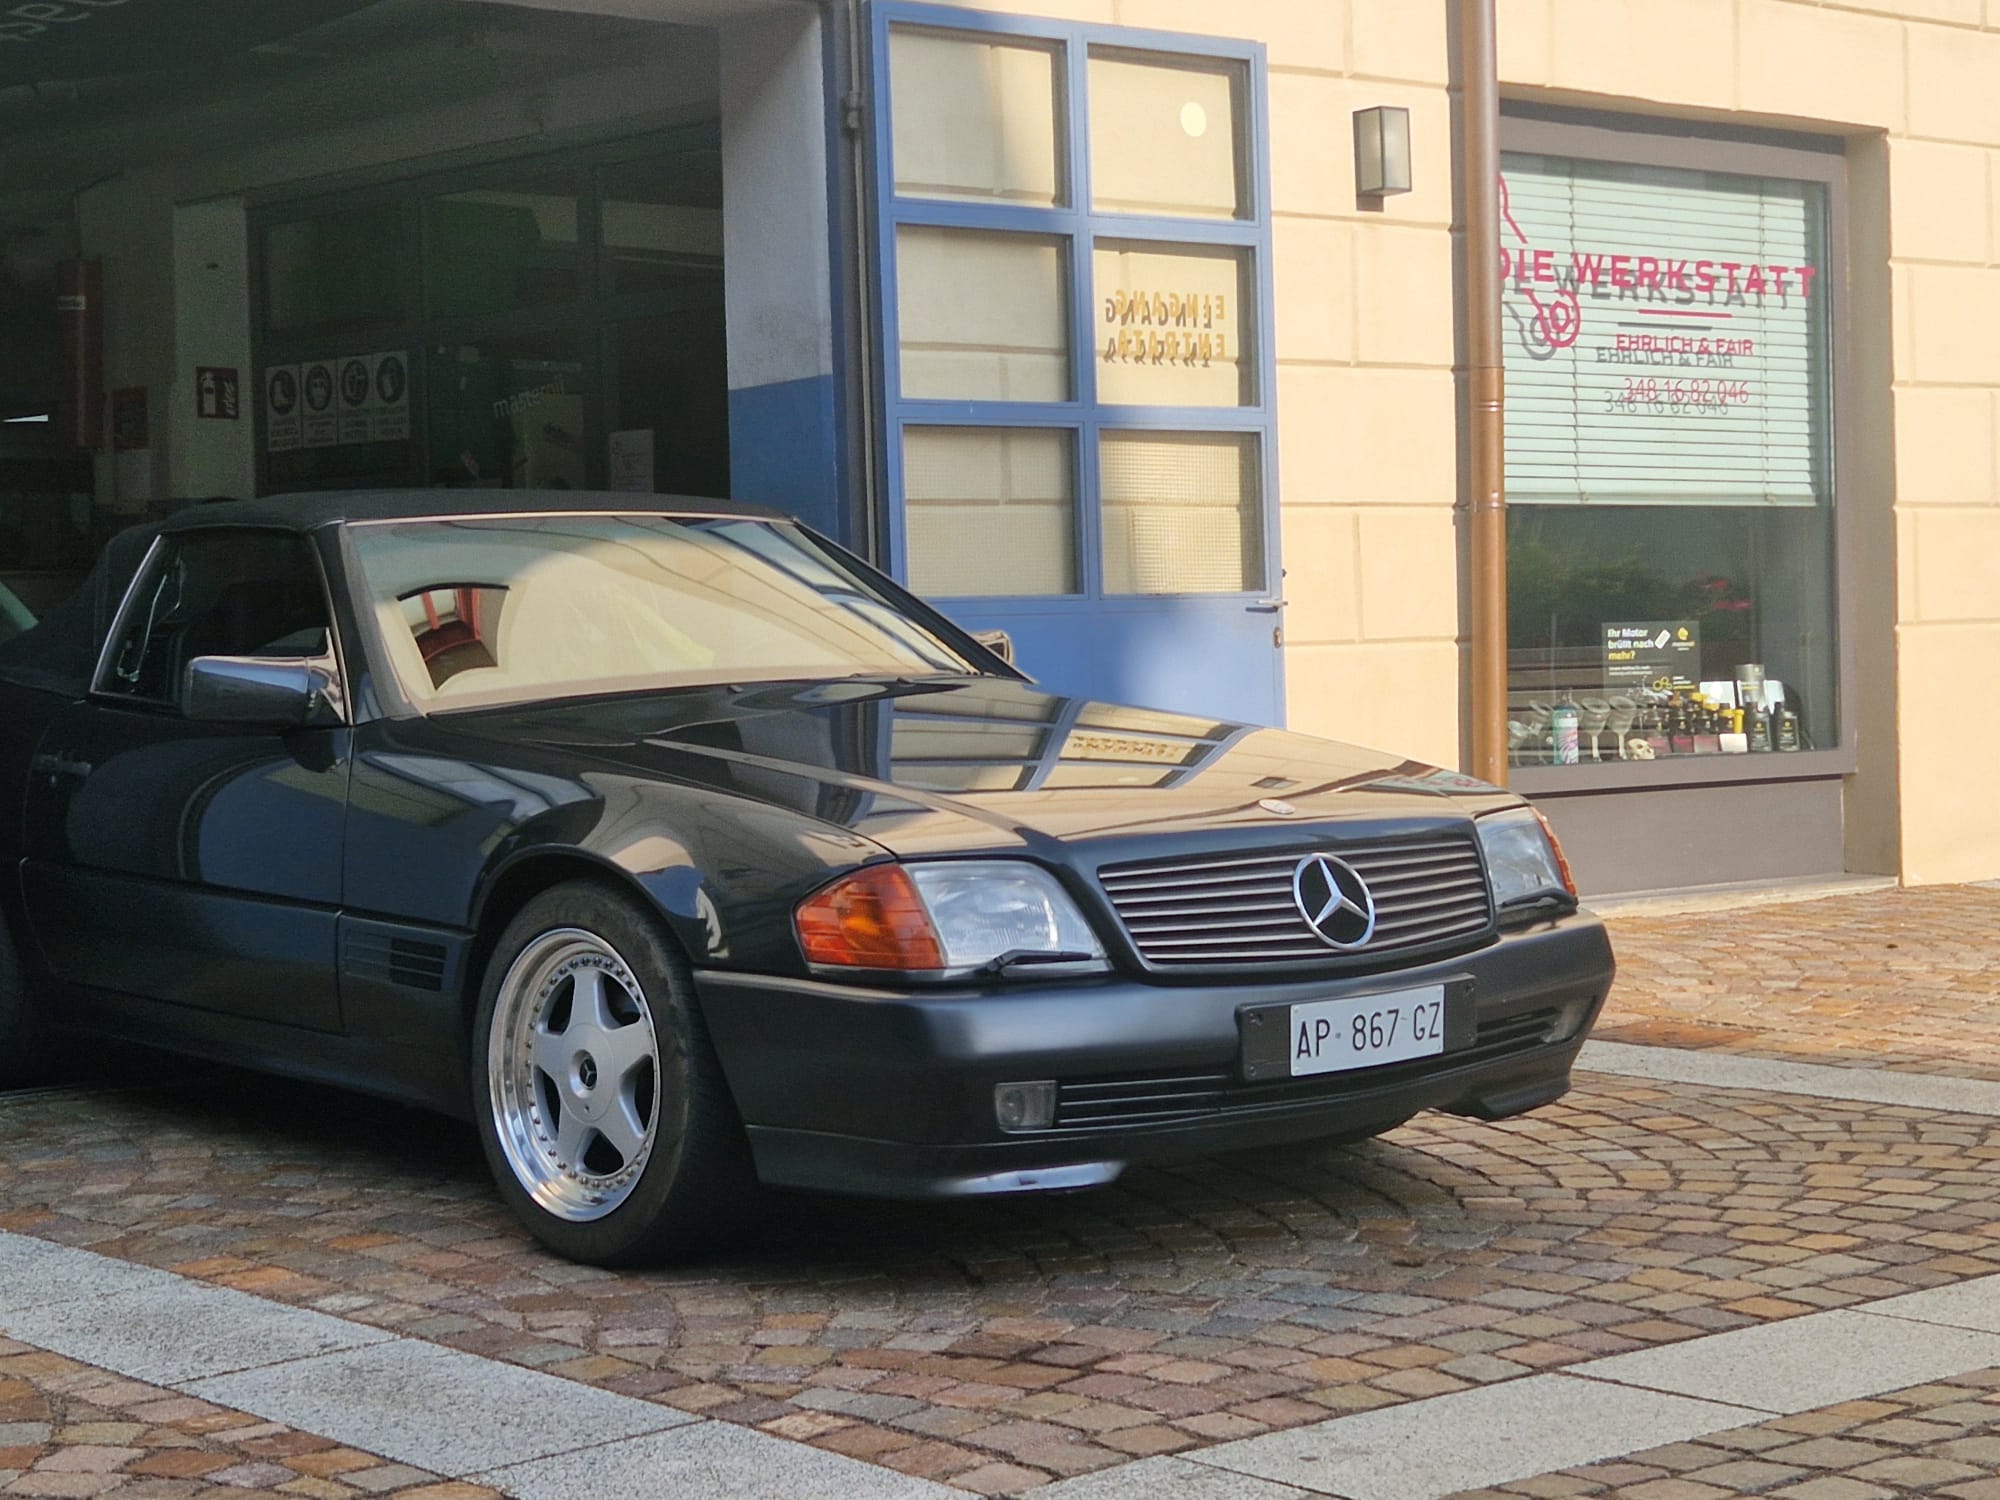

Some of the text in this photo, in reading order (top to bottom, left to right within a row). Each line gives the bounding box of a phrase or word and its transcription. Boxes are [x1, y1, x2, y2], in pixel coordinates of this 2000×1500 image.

[1571, 252, 1816, 298] WERKSTATT
[1616, 334, 1754, 356] EHRLICH & FAIR
[1623, 378, 1750, 404] 348 16 82 046
[1296, 1001, 1441, 1060] AP 867 GZ
